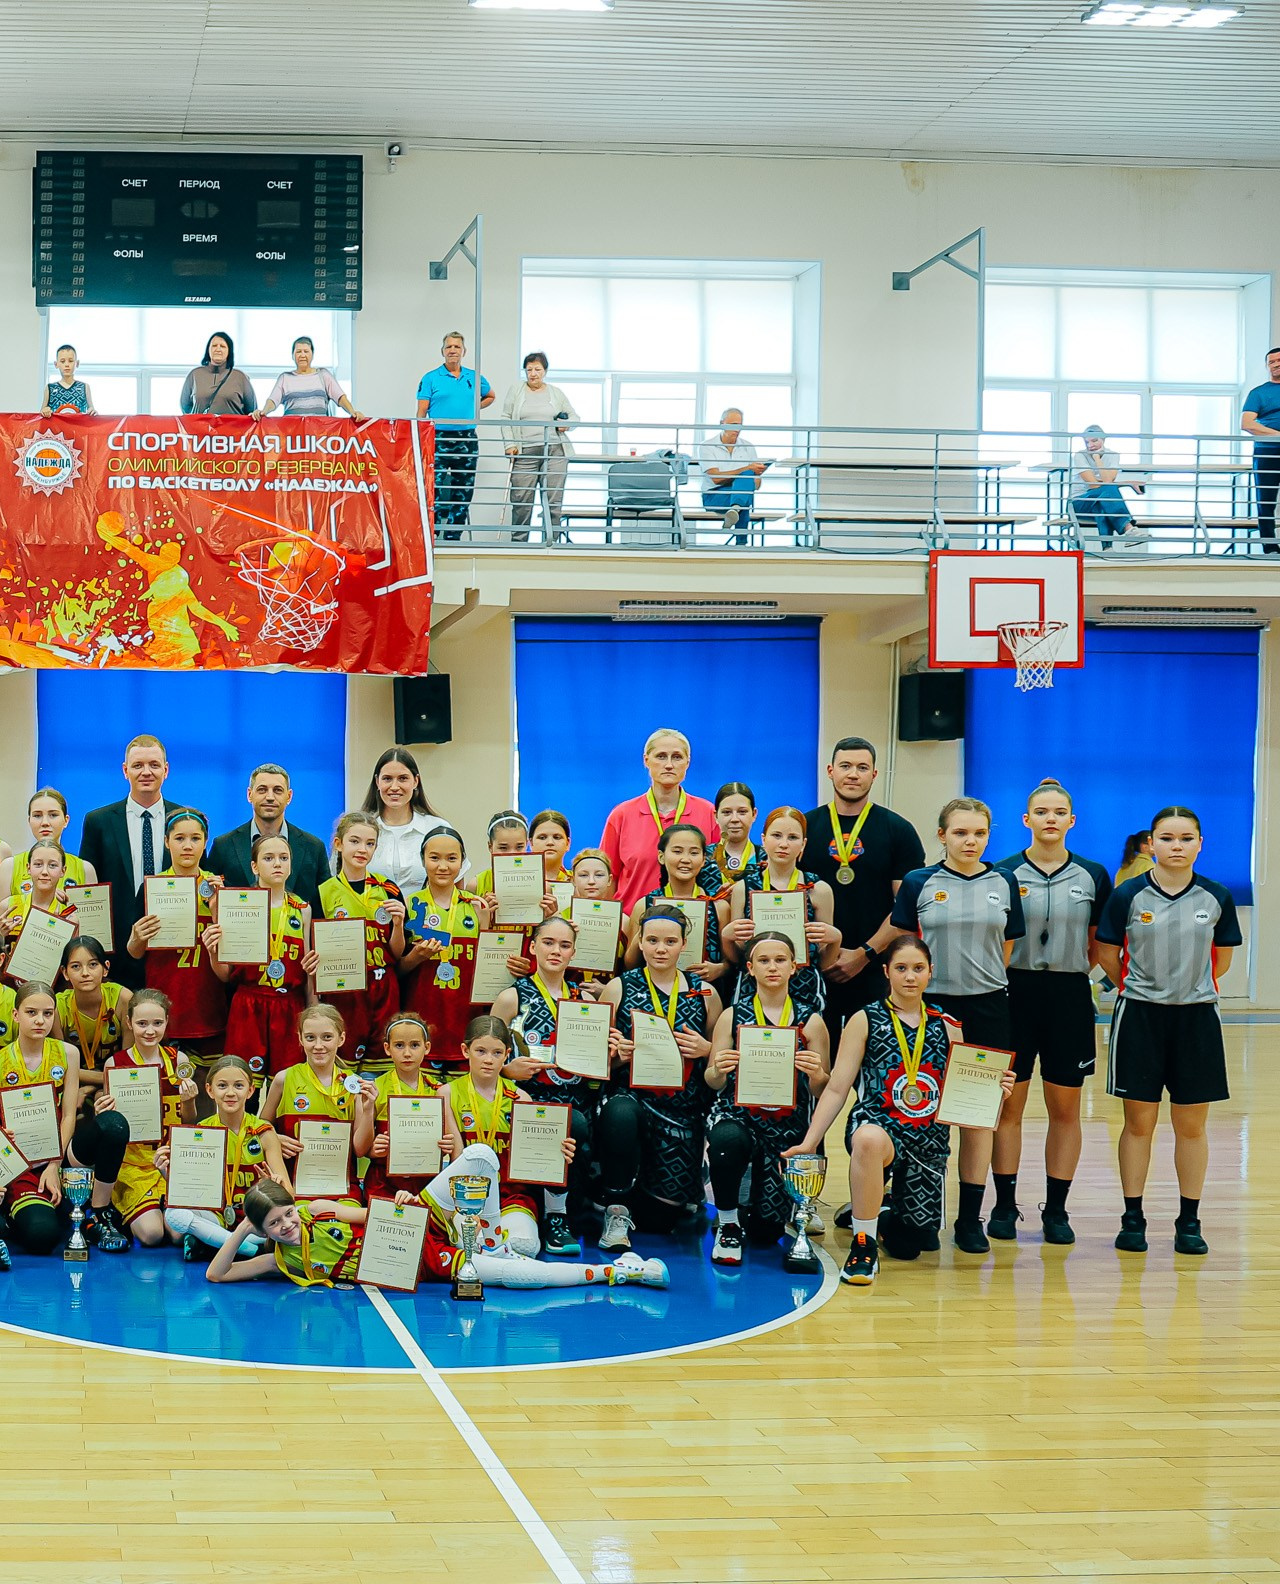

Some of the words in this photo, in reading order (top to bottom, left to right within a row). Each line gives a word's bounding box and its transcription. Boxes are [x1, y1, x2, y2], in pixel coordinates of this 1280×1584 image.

[122, 179, 148, 188] СЧЕТ
[180, 180, 220, 190] ПЕРИОД
[267, 181, 293, 190] СЧЕТ
[183, 234, 218, 242] ВРЕМЯ
[114, 250, 144, 258] ФОЛЫ
[256, 252, 286, 260] ФОЛЫ
[108, 432, 280, 454] СПОРТИВНАЯ
[286, 435, 376, 458] ШКОЛА
[26, 457, 71, 468] НАДЕЖДА
[108, 456, 260, 475] ОЛИМПИЙСКОГО
[265, 460, 348, 476] РЕЗЕРВА
[368, 464, 378, 476] 5
[108, 476, 134, 489] ПО
[139, 477, 259, 492] БАСКЕТБОЛУ
[264, 478, 378, 494] «НАДЕЖДА»
[226, 910, 260, 918] ДИПЛОМ
[580, 919, 612, 928] ДИПЛОМ
[30, 930, 62, 947] ДИПЛОМ
[466, 944, 474, 960] 5
[177, 948, 200, 968] 27
[324, 964, 358, 972] ДИПЛОМ
[566, 1024, 601, 1032] ДИПЛОМ
[642, 1032, 670, 1042] ДИПЛОМ
[748, 1050, 786, 1058] ДИПЛОМ
[956, 1068, 996, 1081] ДИПЛОМ
[118, 1089, 152, 1098] ДИПЛОМ
[13, 1108, 48, 1120] ДИПЛОМ
[398, 1120, 434, 1128] ДИПЛОМ
[521, 1126, 558, 1134] ДИПЛОМ
[178, 1150, 216, 1159] ДИПЛОМ
[375, 1224, 415, 1238] ДИПЛОМ
